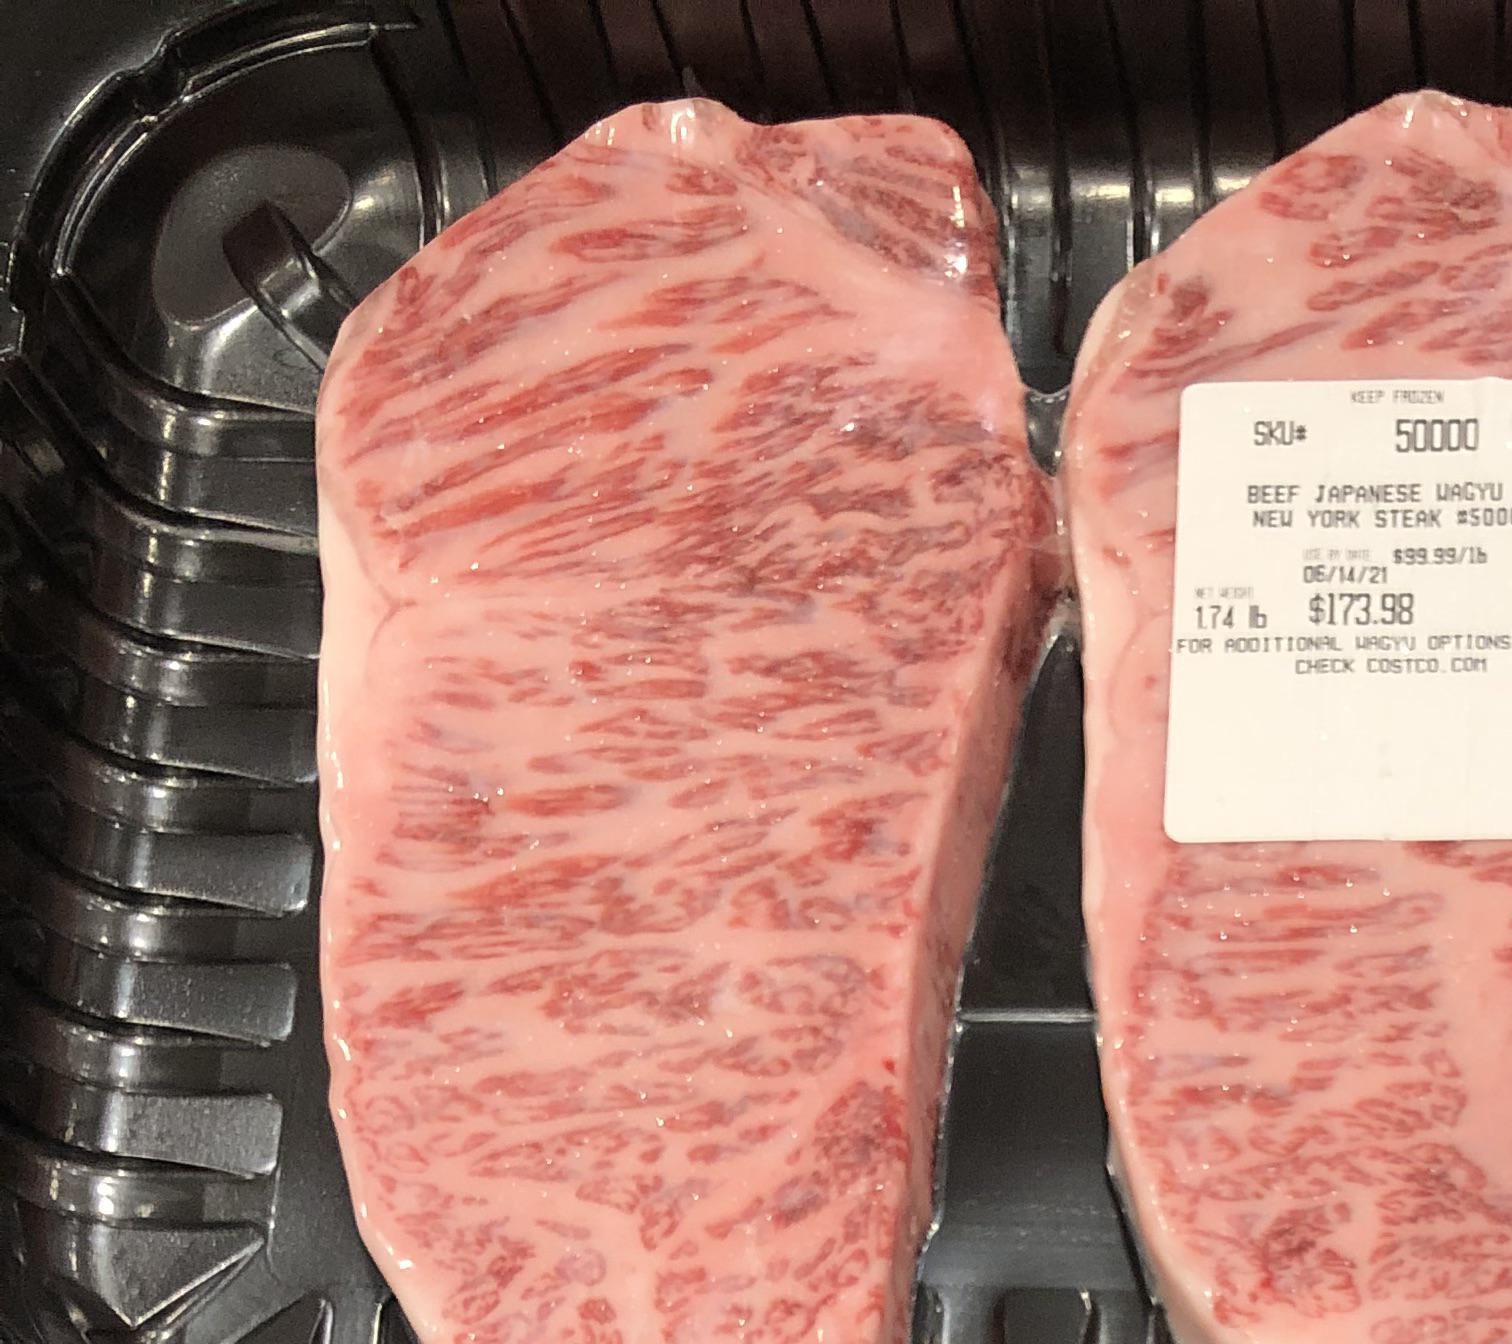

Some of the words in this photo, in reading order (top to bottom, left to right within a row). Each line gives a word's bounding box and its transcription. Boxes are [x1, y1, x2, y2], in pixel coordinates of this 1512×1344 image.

[1253, 420, 1307, 446] SKU#
[1395, 417, 1479, 453] 50000
[1247, 484, 1300, 505] BEEF
[1314, 483, 1421, 504] JAPANESE
[1436, 481, 1503, 502] WAGYU
[1252, 510, 1293, 528] NEW
[1307, 509, 1360, 529] YORK
[1374, 508, 1442, 529] STEAK
[1303, 564, 1388, 585] 06/14/21
[1248, 604, 1268, 629] lb
[1309, 592, 1415, 626] $173.98
[1176, 638, 1213, 654] FOR
[1224, 635, 1343, 654] ADDITIONAL
[1427, 633, 1511, 651] OPTIONS
[1295, 658, 1355, 675] CHECK
[1366, 656, 1487, 674] COSTCO.COM
